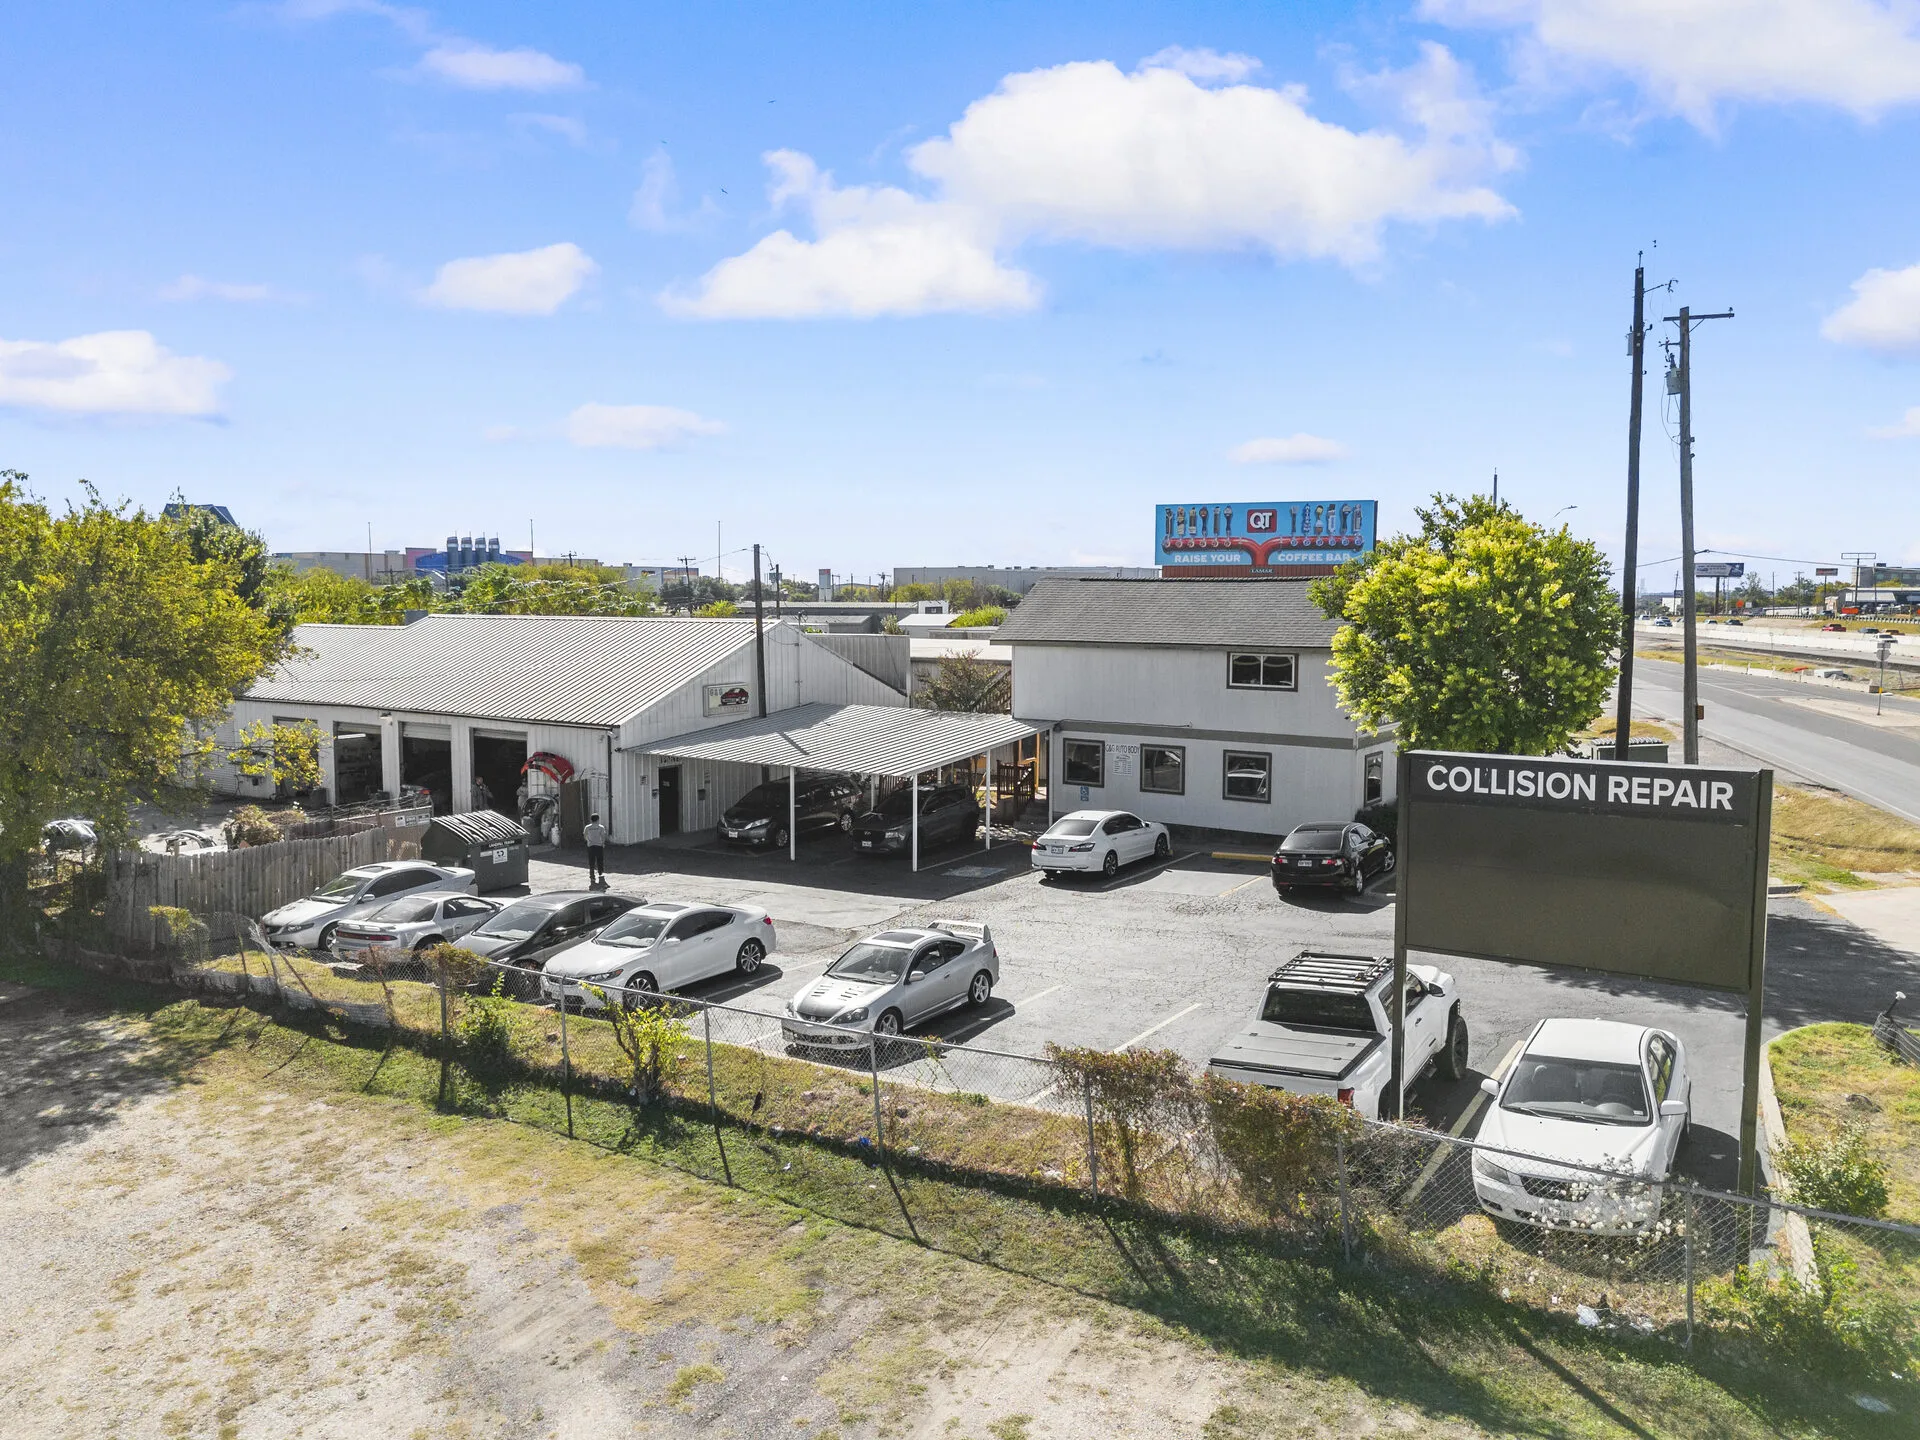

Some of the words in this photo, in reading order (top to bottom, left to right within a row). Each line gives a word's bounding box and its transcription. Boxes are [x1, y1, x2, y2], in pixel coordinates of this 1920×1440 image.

[1249, 511, 1273, 530] QT
[1174, 553, 1207, 563] RAISE
[1210, 553, 1241, 563] YOUR
[1277, 552, 1324, 562] COFFEE
[1326, 553, 1351, 562] BAR
[1426, 764, 1597, 801] COLLISION
[1607, 775, 1734, 811] REPAIR
